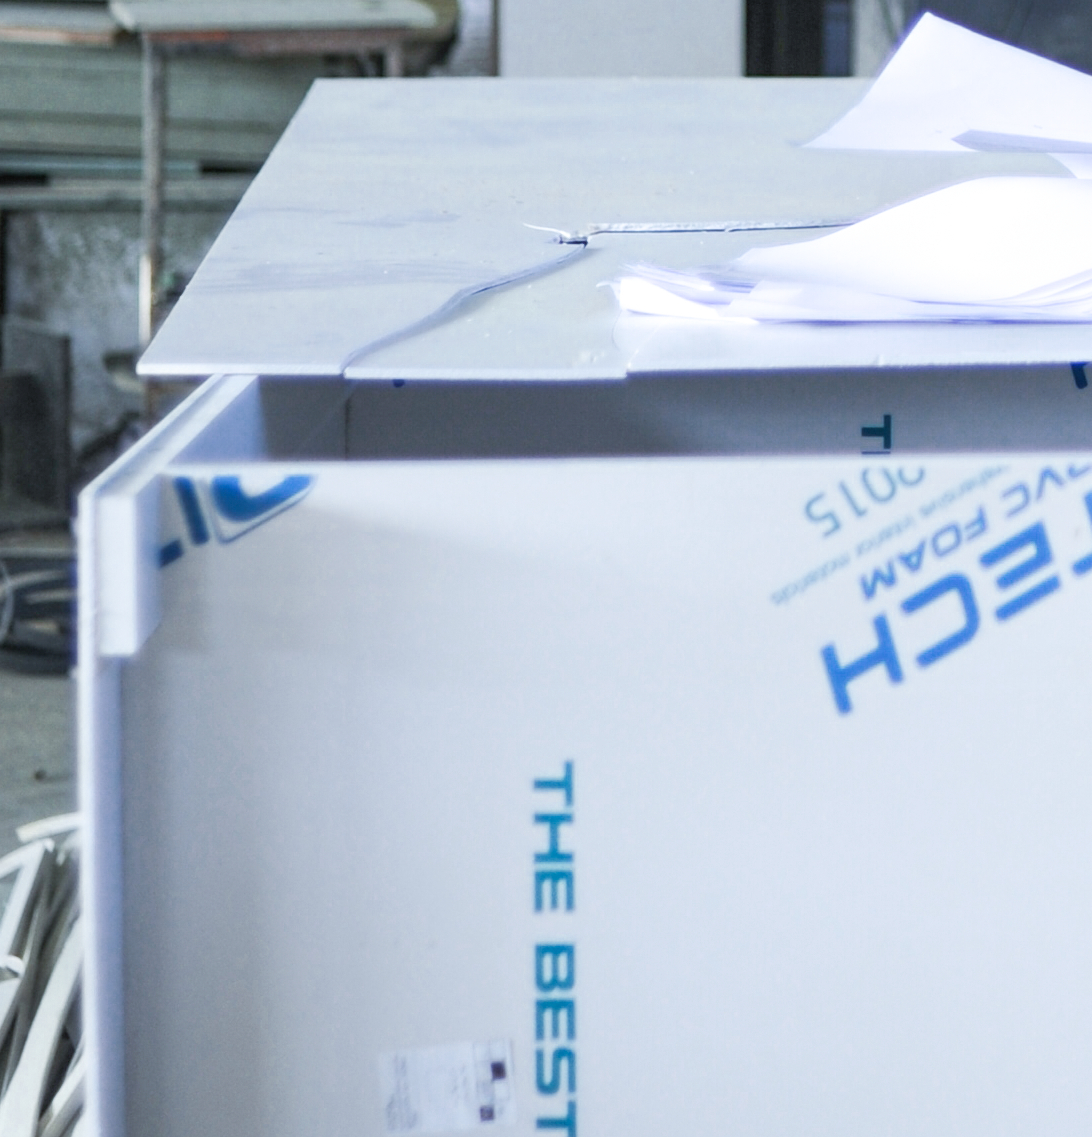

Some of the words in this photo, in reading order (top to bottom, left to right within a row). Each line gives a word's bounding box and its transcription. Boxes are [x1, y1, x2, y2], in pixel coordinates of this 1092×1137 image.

[860, 503, 988, 601] FOAM
[533, 760, 575, 912] THE
[534, 944, 578, 1137] BEST
